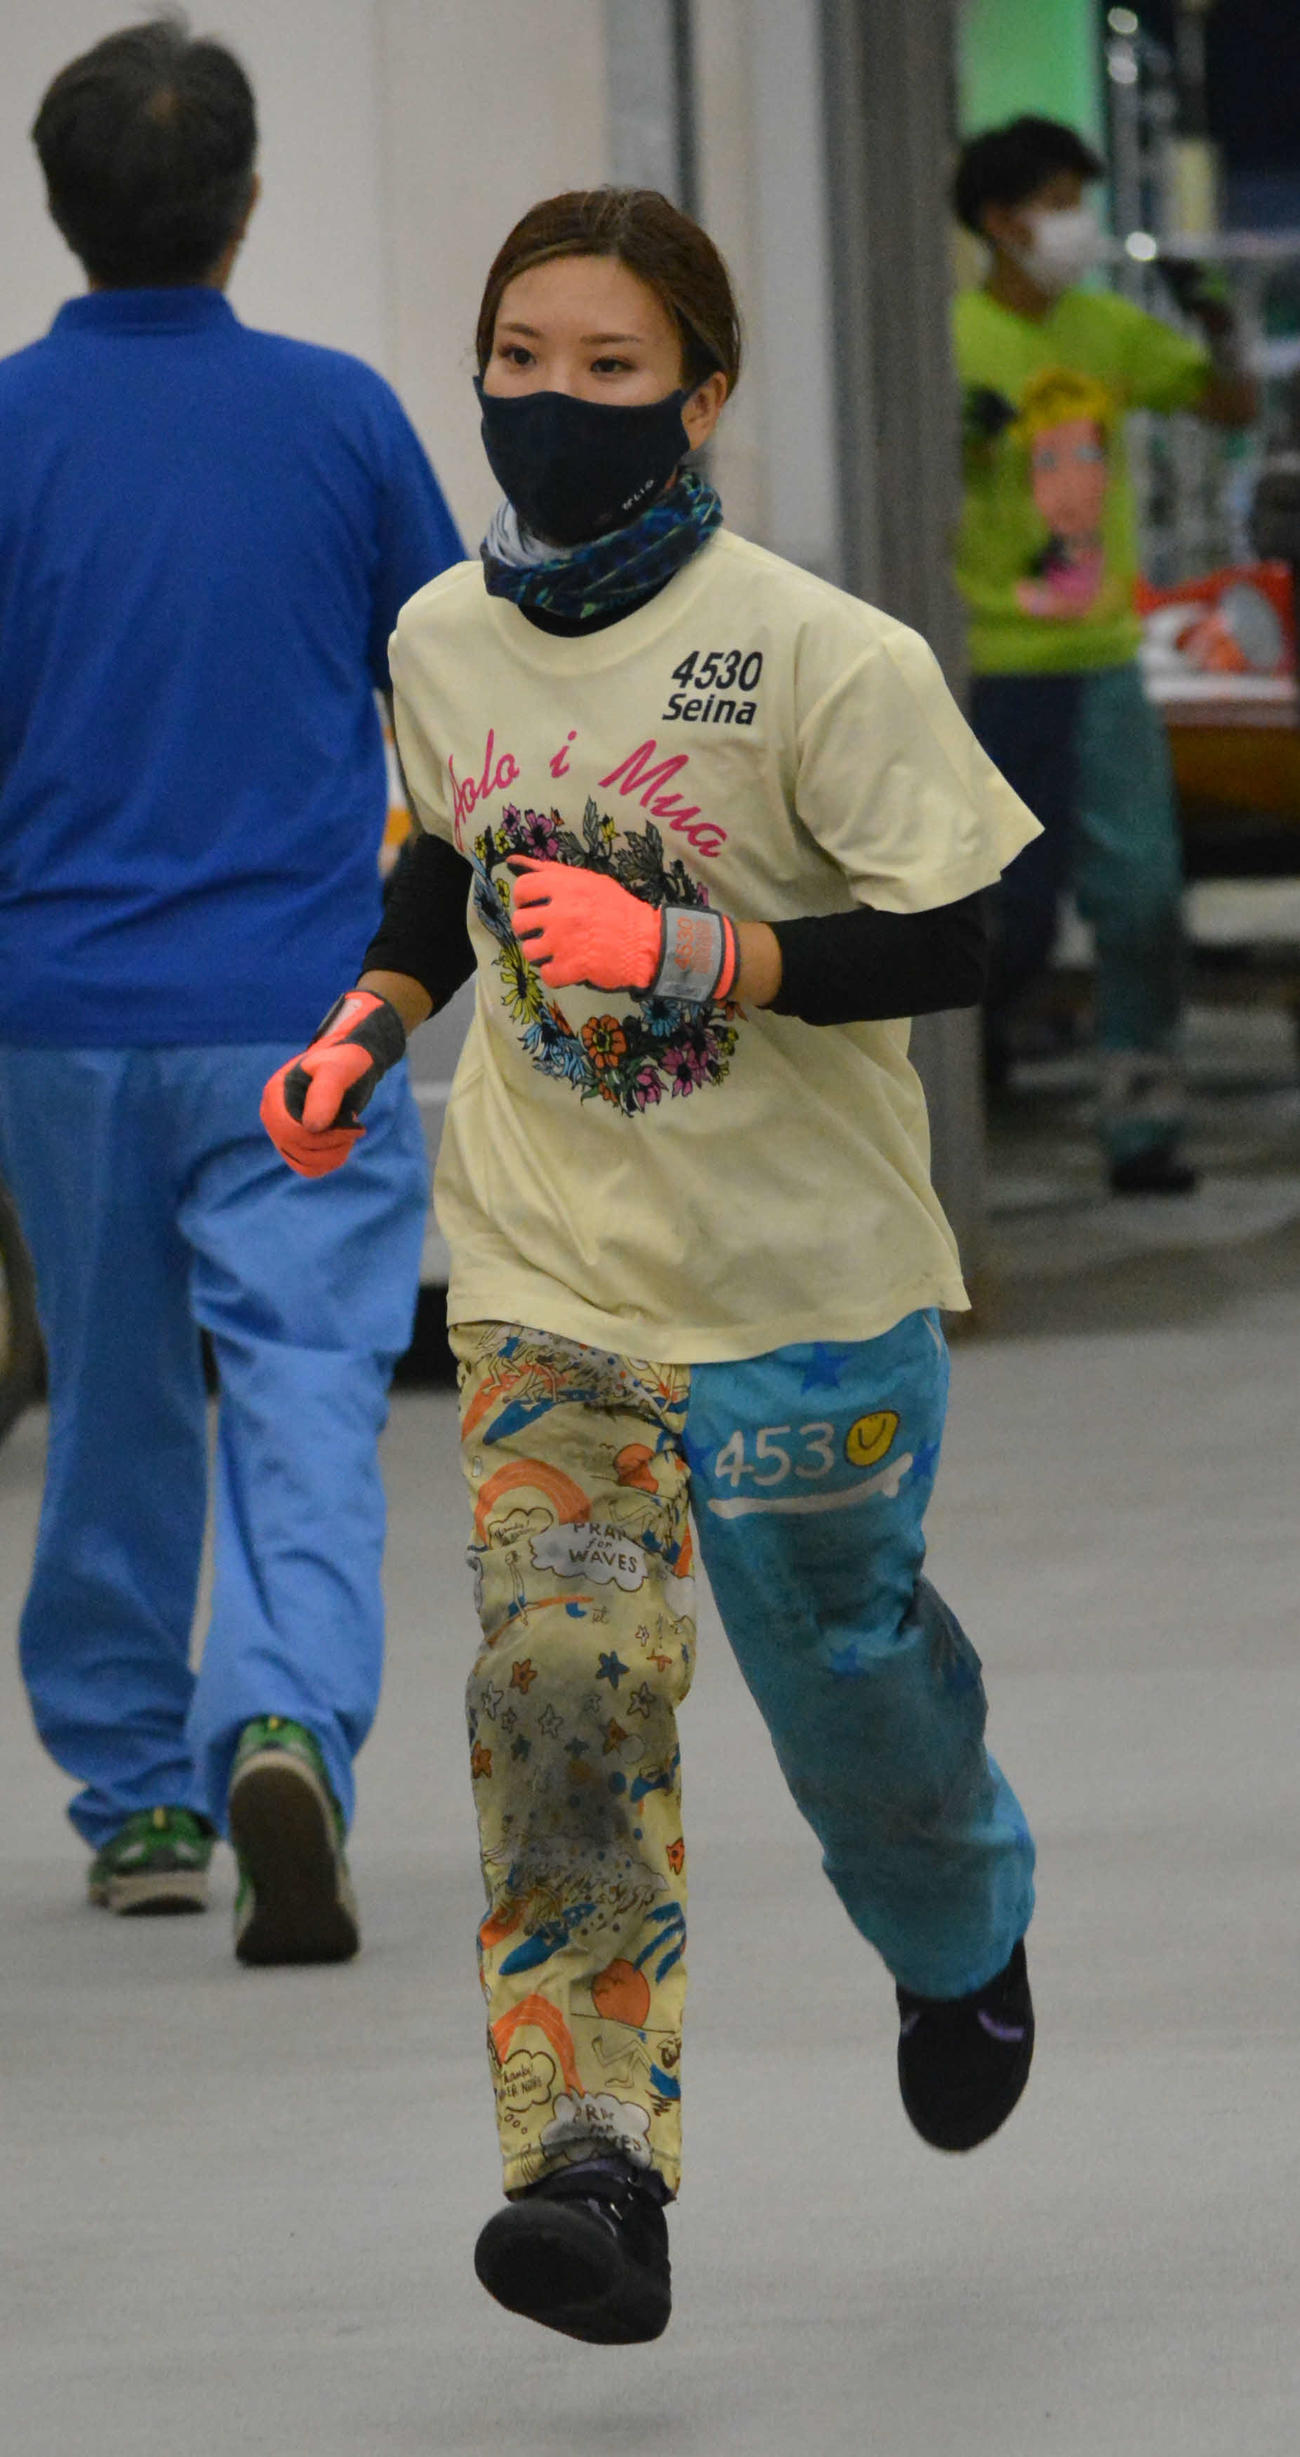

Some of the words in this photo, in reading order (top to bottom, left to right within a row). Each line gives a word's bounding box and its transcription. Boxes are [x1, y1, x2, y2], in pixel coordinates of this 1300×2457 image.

[671, 649, 763, 692] 4530
[661, 692, 758, 725] Seina
[549, 730, 577, 778] i
[598, 738, 728, 858] Mua
[568, 1549, 637, 1573] WAVES
